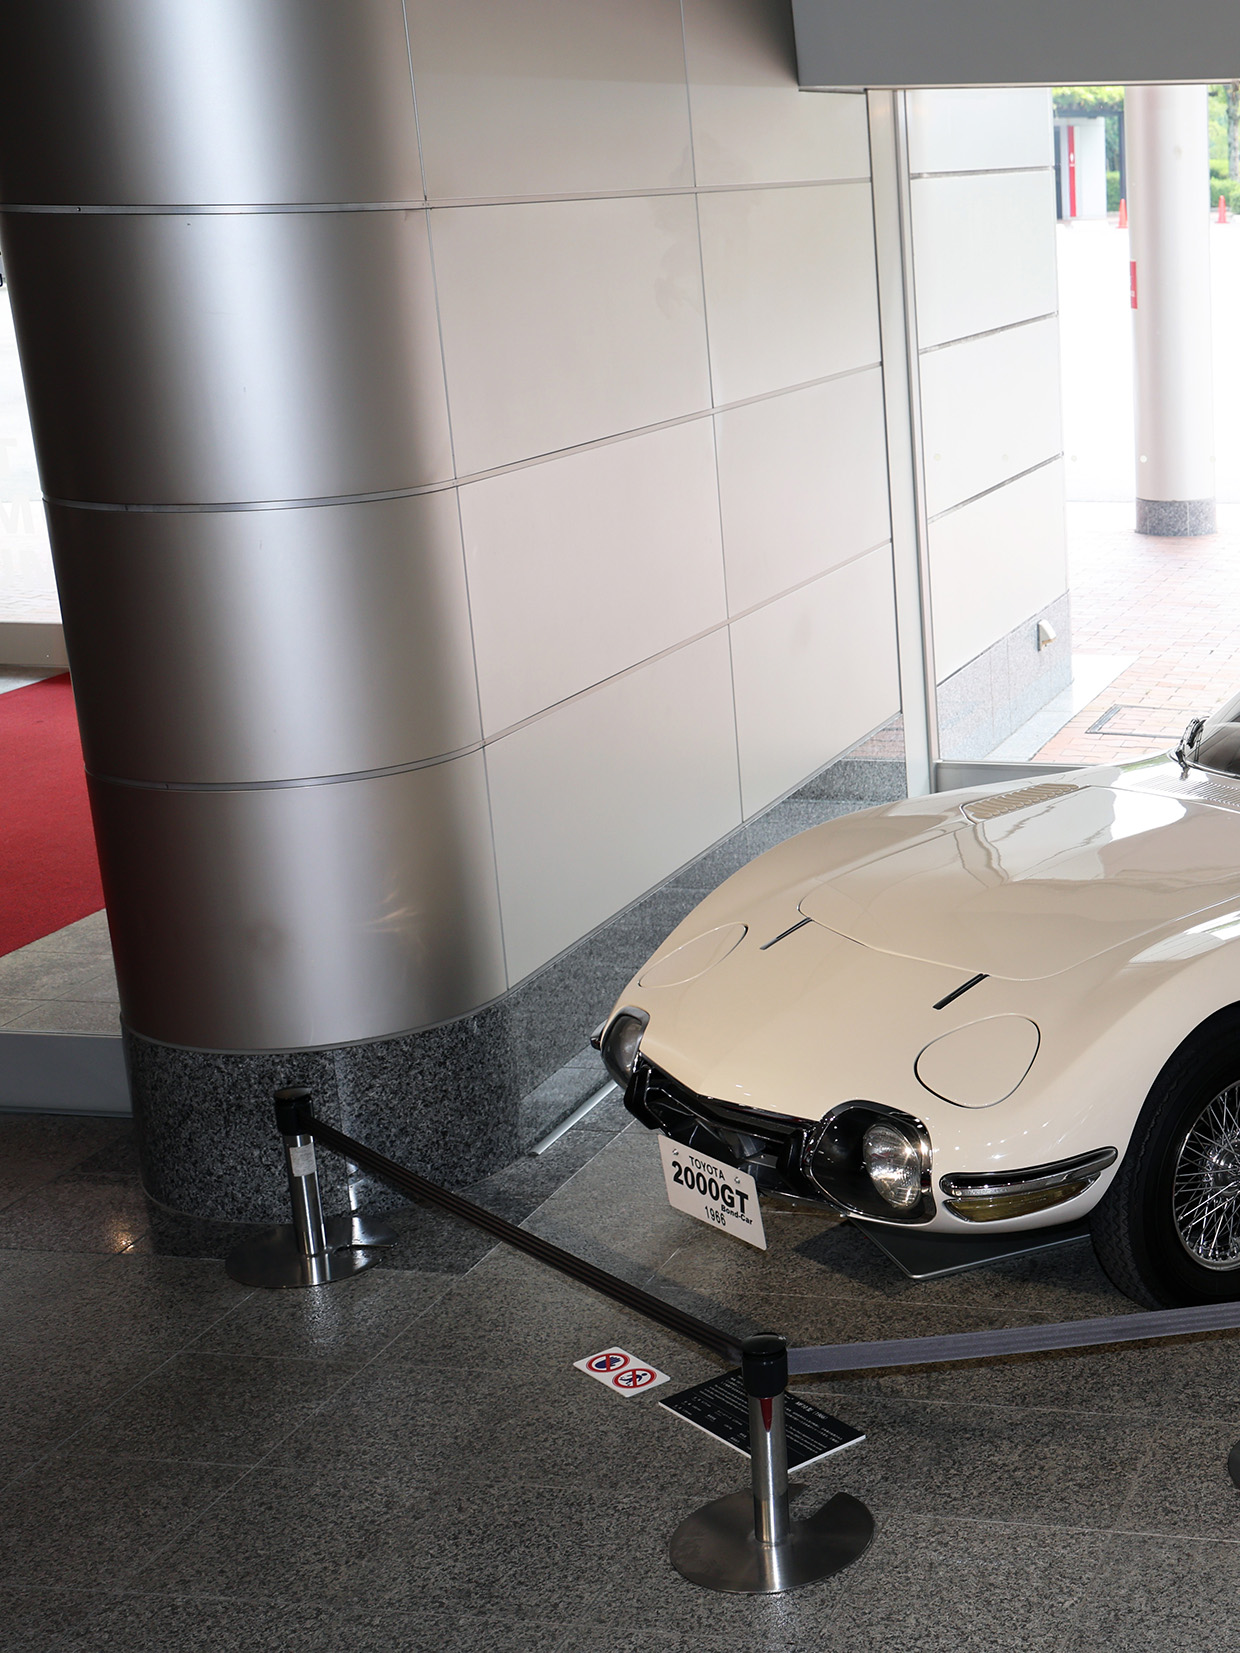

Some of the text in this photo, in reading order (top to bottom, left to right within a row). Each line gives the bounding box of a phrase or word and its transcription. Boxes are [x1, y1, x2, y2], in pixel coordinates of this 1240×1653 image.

[689, 1155, 726, 1181] TOYOTA
[671, 1160, 749, 1214] 2000GT
[704, 1205, 727, 1227] 1966
[720, 1204, 753, 1225] Bond-Car
